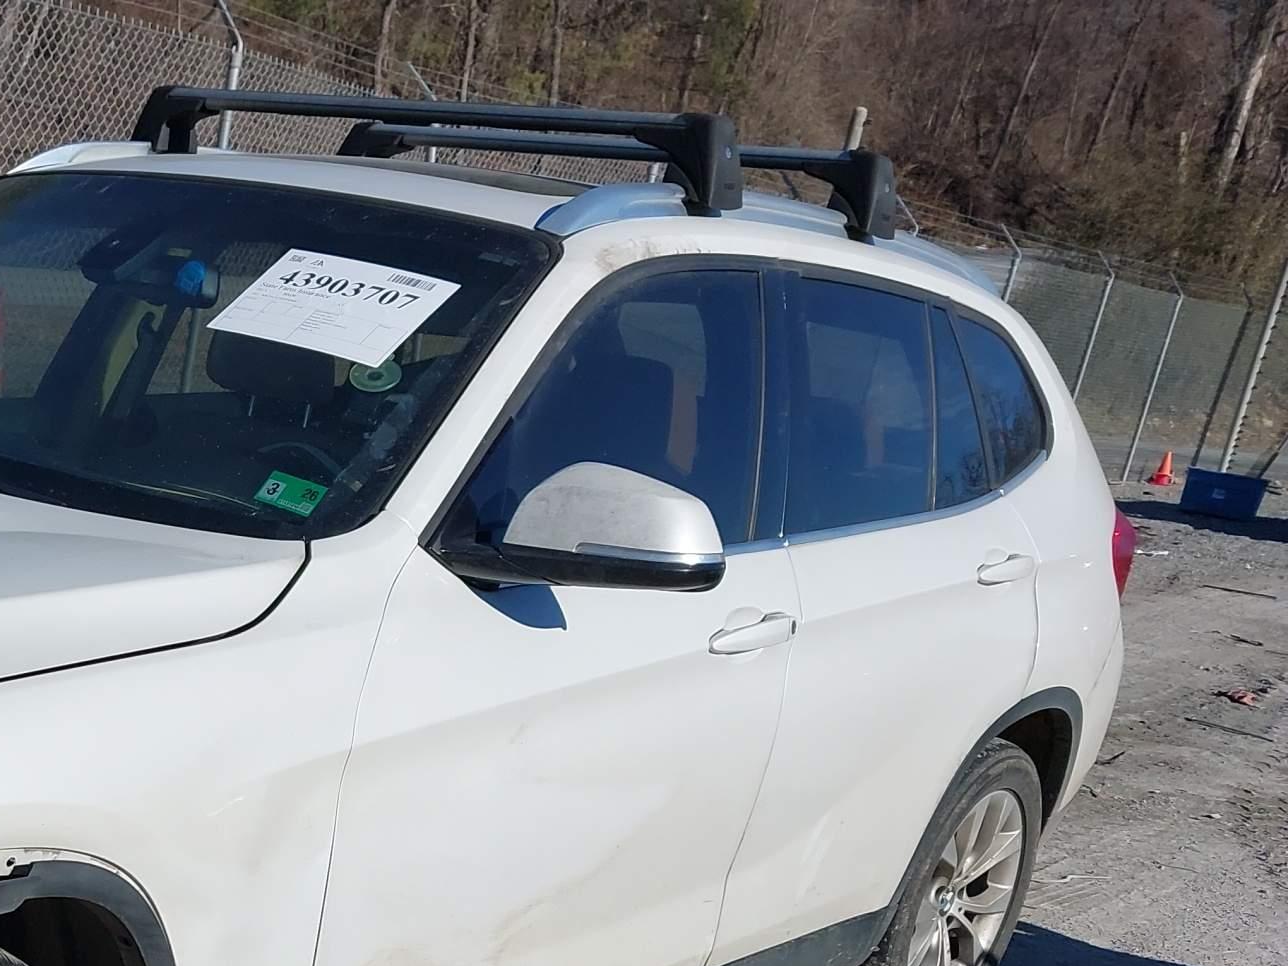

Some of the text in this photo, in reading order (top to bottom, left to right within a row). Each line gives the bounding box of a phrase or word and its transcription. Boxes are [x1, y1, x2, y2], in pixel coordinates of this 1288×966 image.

[279, 269, 420, 310] 43903707
[266, 482, 320, 502] 3 26
